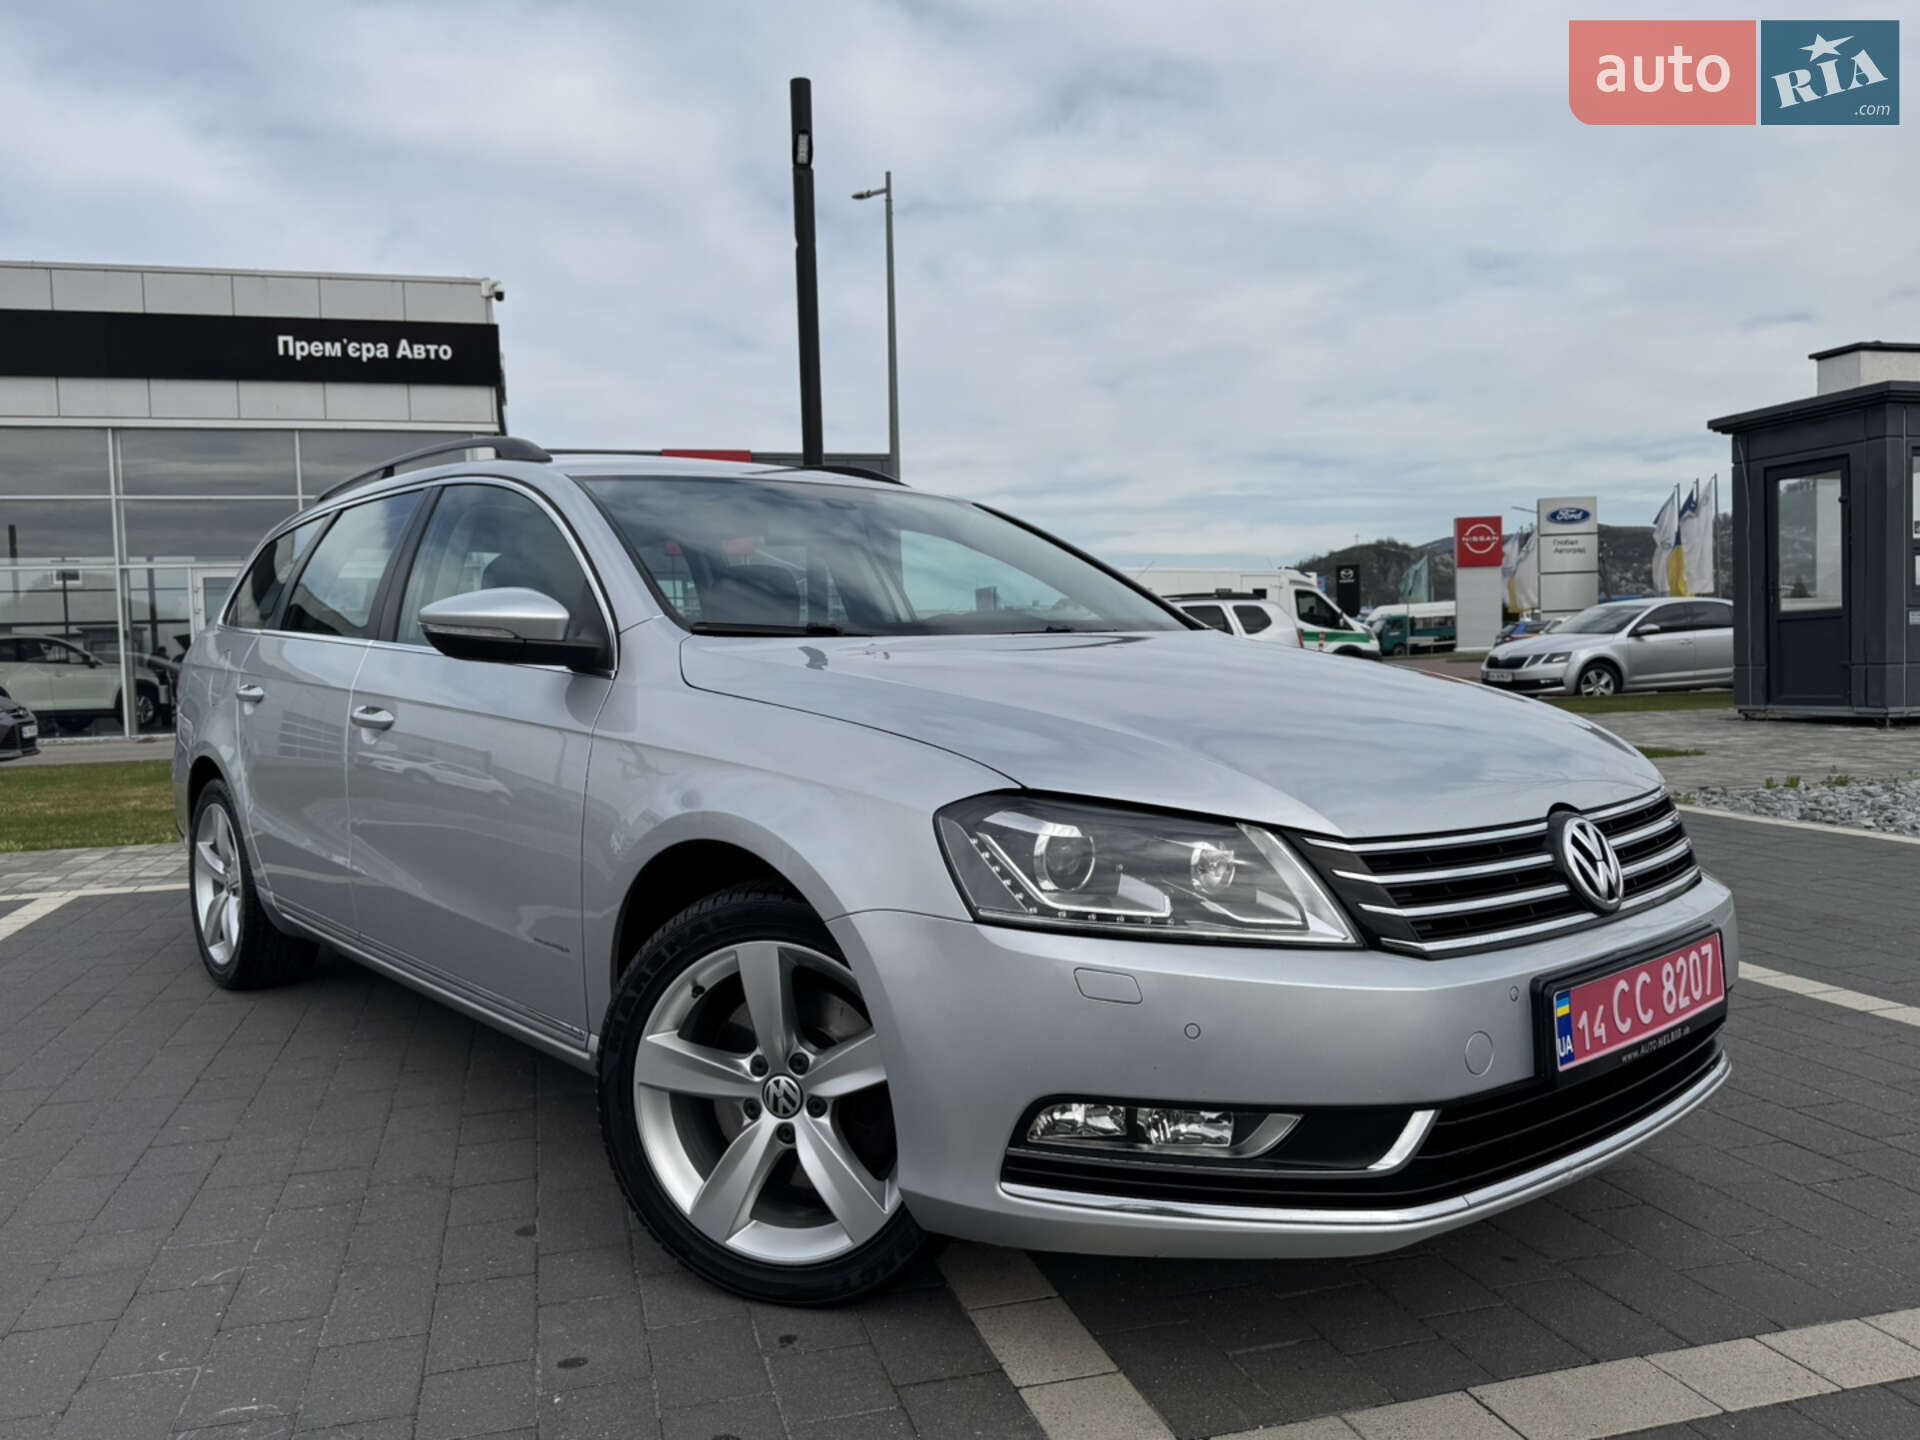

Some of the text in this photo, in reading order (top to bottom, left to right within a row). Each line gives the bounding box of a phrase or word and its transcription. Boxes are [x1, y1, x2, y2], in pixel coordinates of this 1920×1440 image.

[277, 335, 453, 362] Прем'єра Авто
[1555, 508, 1584, 521] Ford
[1461, 535, 1499, 543] NISSAN
[1578, 943, 1712, 1051] 14 CC 8207
[1558, 1035, 1573, 1057] UA
